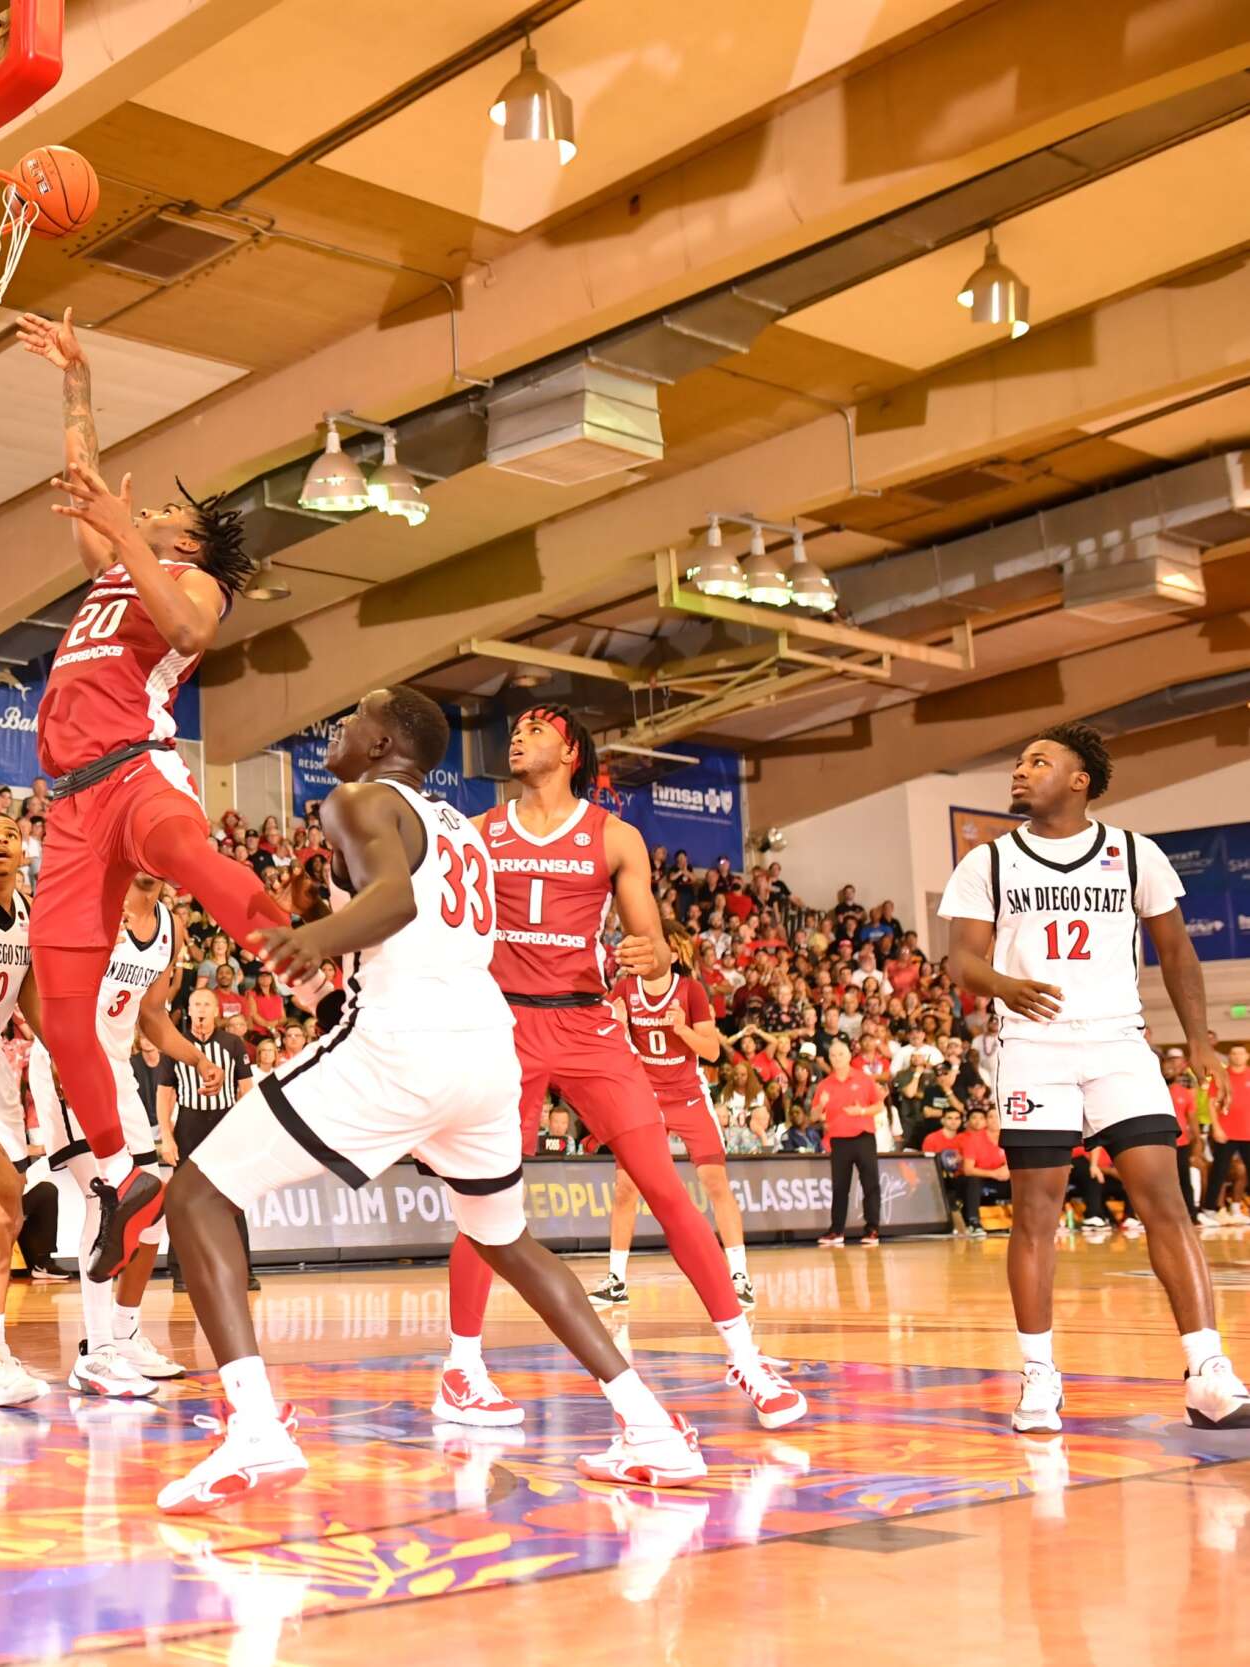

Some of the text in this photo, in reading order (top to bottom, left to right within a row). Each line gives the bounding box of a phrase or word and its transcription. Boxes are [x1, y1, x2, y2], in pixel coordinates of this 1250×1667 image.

[66, 598, 129, 648] 20
[0, 706, 39, 733] Bah
[489, 858, 595, 875] ARKANSAS
[437, 834, 493, 936] 33
[529, 879, 544, 924] 1
[1006, 886, 1128, 914] SAN DIEGO STATE
[1044, 919, 1091, 960] 12
[114, 962, 144, 986] DIEGO
[107, 990, 131, 1017] 3
[649, 1030, 667, 1055] 0
[333, 1186, 388, 1225] JIM
